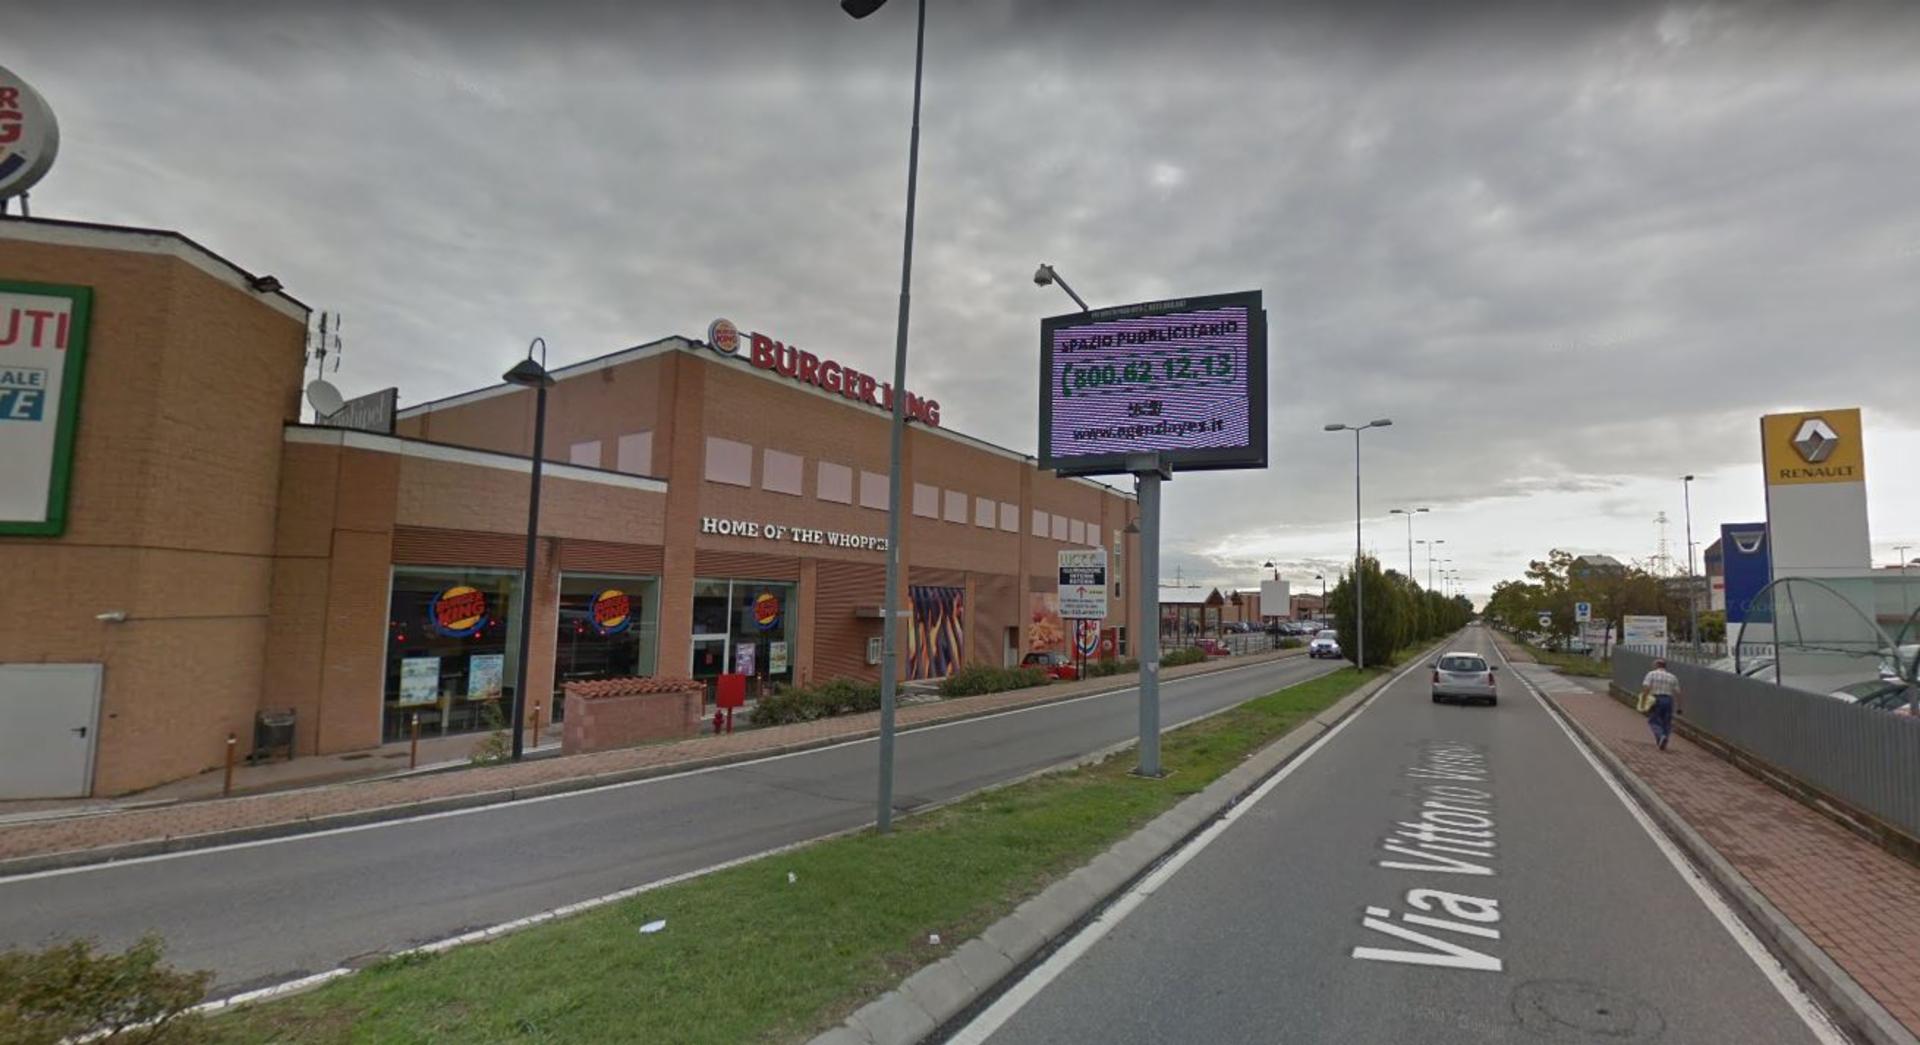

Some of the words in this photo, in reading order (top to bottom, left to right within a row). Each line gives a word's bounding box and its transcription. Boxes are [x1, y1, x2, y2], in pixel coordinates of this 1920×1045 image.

[1061, 335, 1113, 353] SPAZIO
[1116, 320, 1238, 347] PUBBLICITARIO
[751, 331, 878, 406] BURGER
[1779, 466, 1856, 479] RENAULT
[702, 517, 760, 537] HOME
[763, 524, 786, 540] OF
[790, 527, 823, 544] THE
[438, 601, 485, 626] KING
